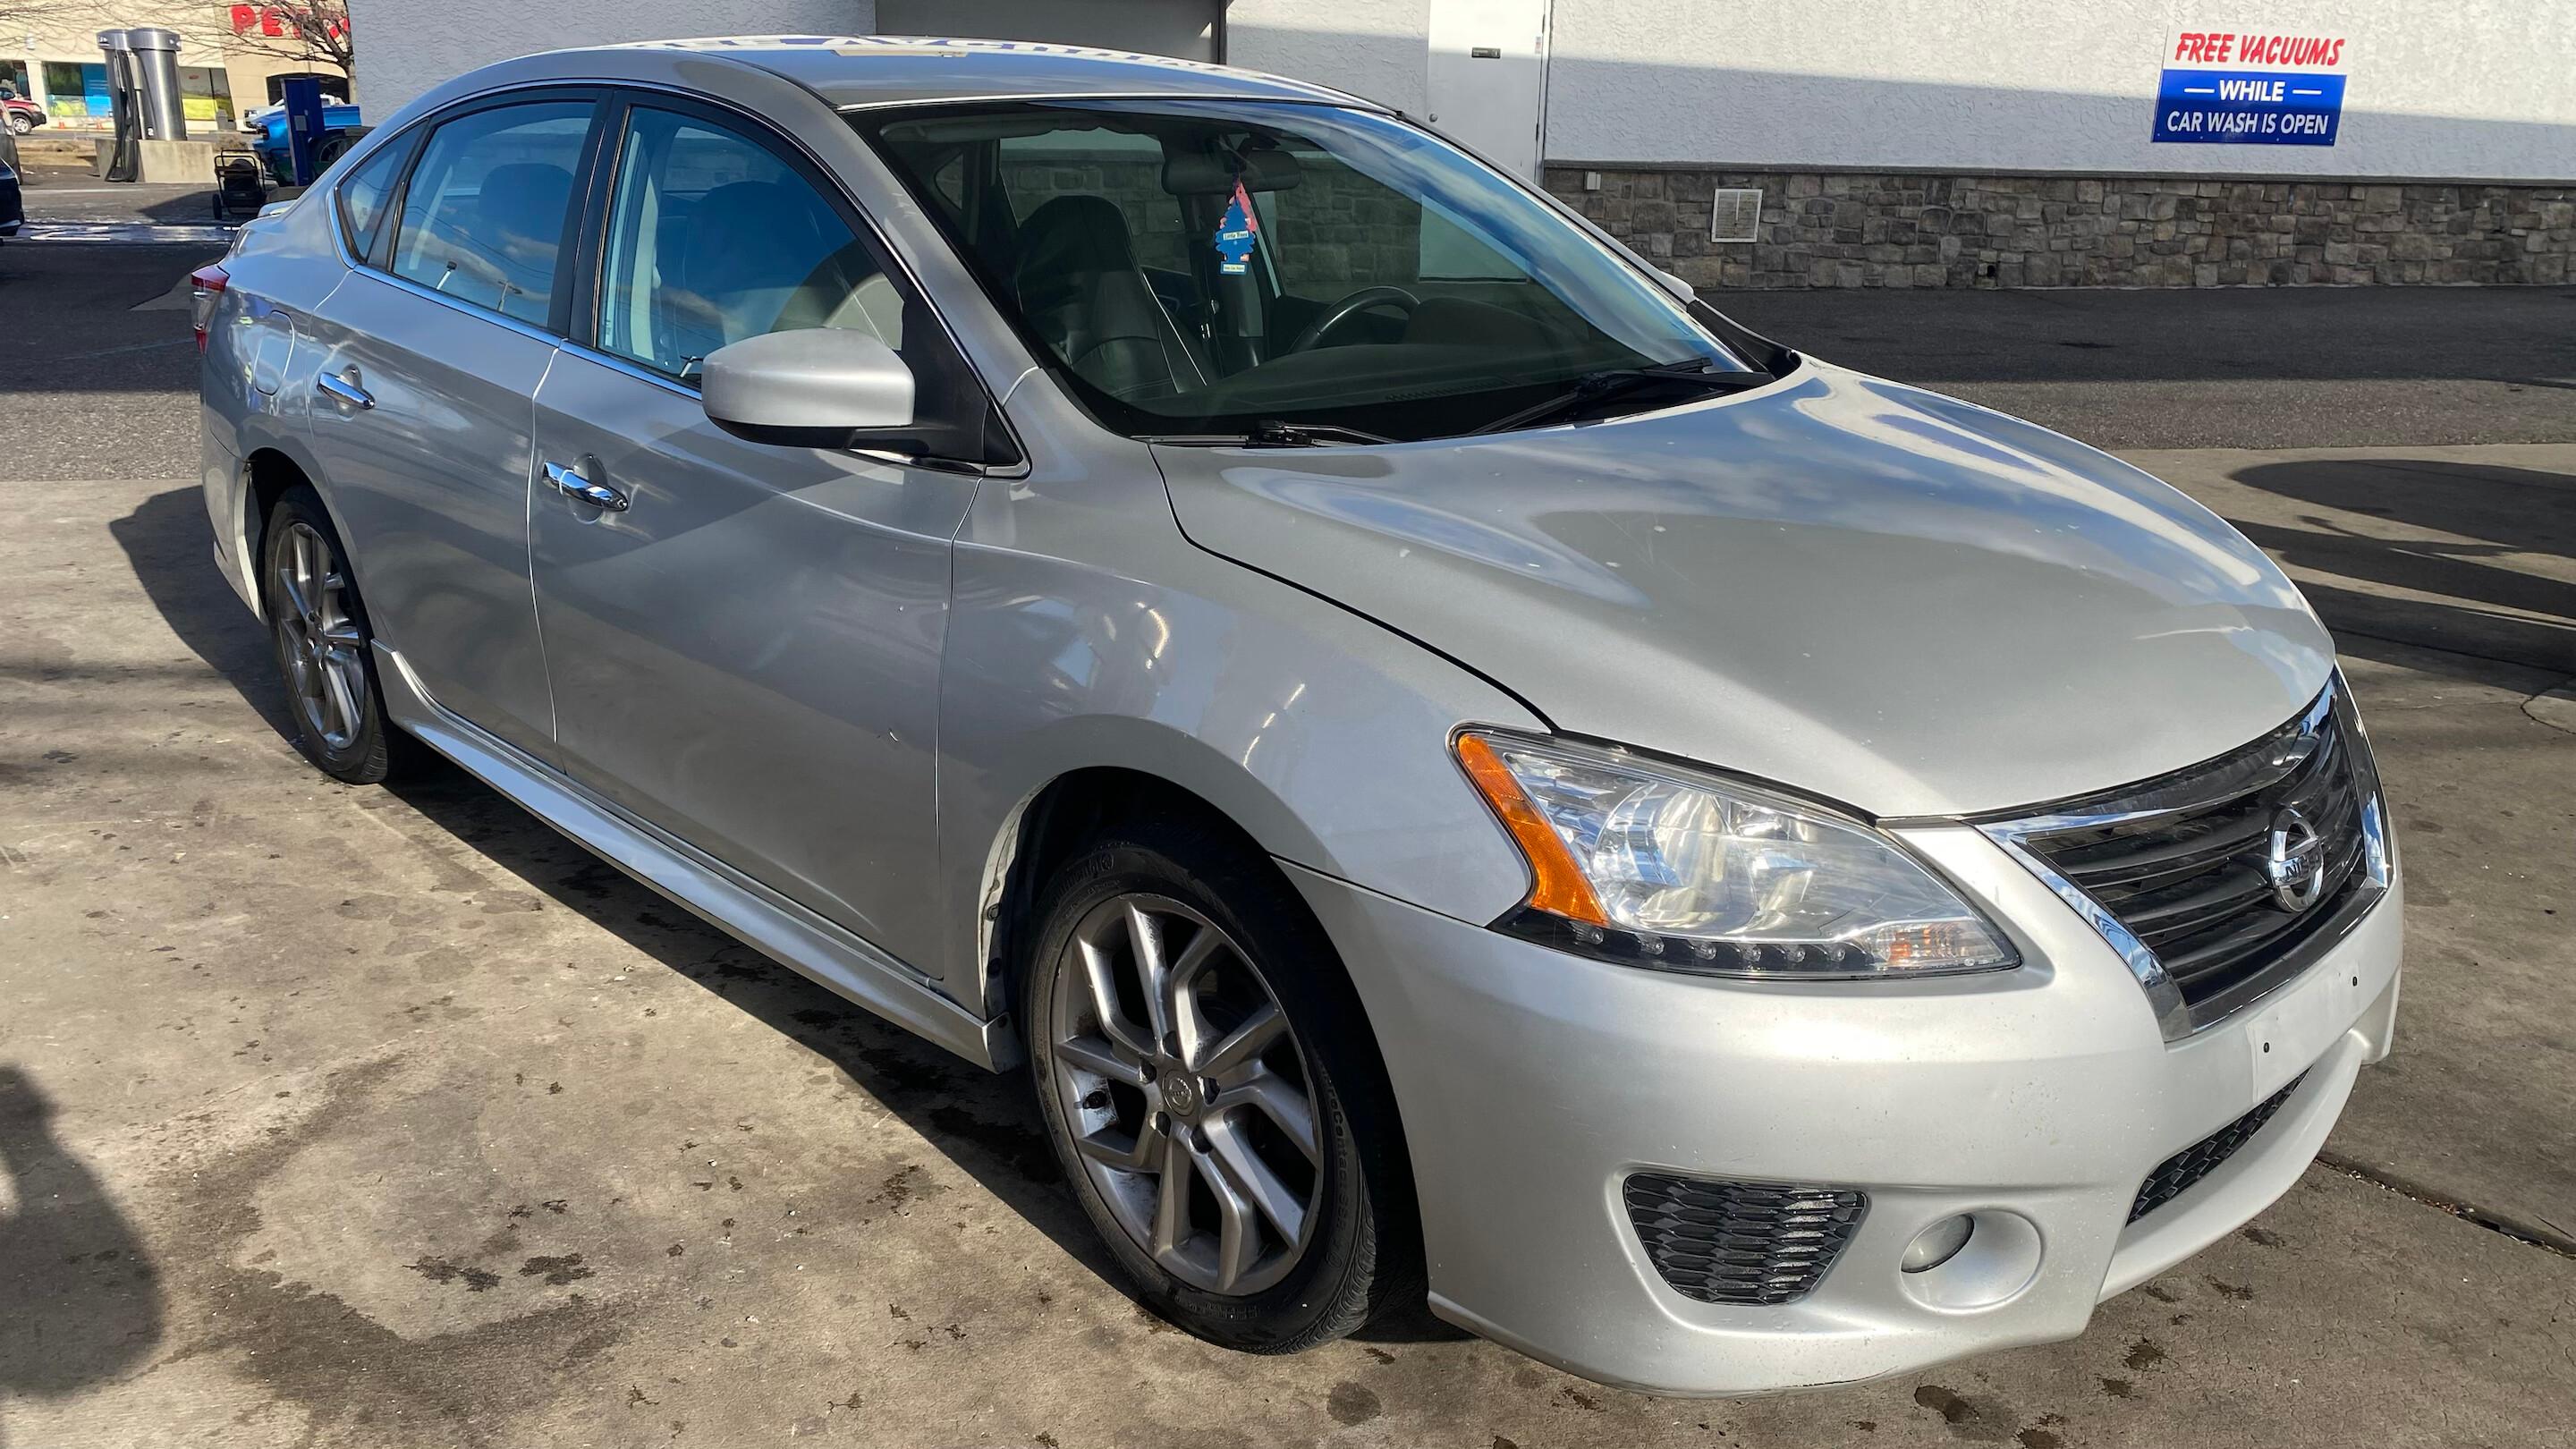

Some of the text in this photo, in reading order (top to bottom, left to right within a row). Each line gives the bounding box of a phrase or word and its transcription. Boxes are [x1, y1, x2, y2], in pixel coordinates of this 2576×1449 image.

[2174, 32, 2345, 66] FREE VACUUMS
[2219, 79, 2285, 102] WHILE
[2167, 111, 2329, 135] CAR WASH IS OPEN
